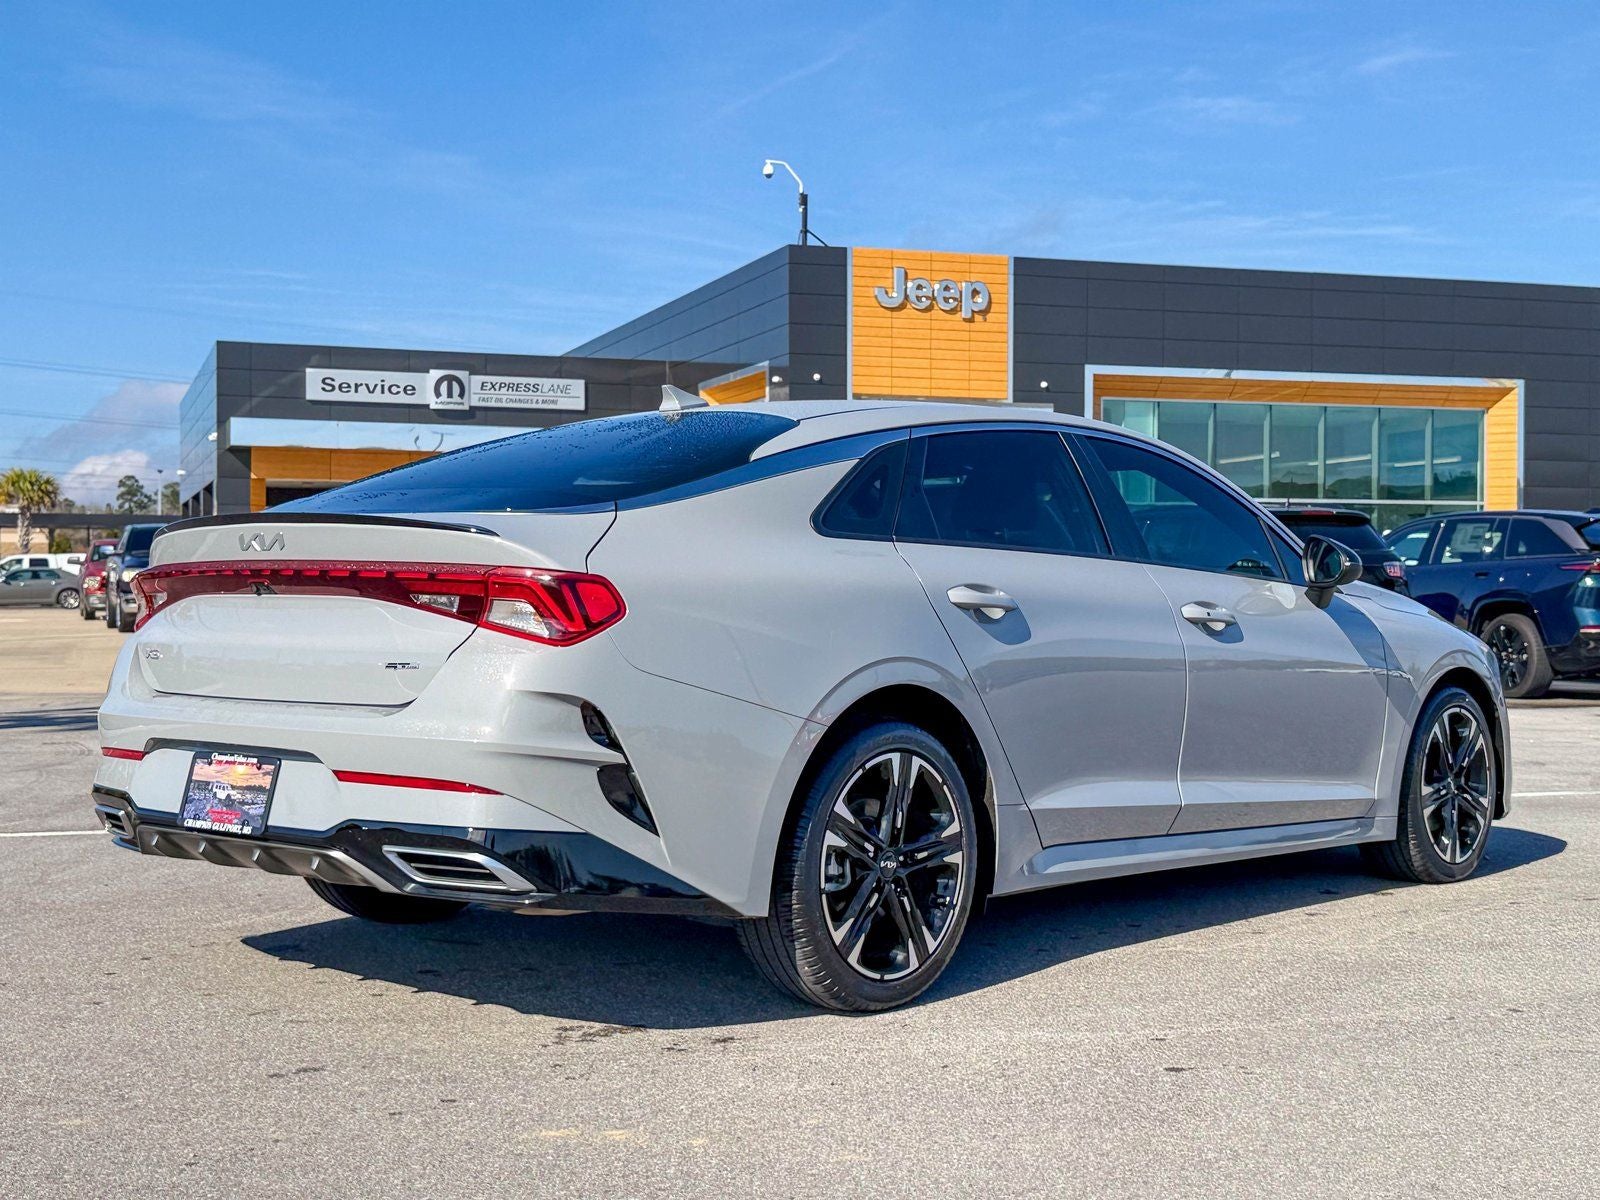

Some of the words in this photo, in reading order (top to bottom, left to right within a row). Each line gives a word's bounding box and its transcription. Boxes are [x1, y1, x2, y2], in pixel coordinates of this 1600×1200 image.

[873, 266, 990, 319] Jeep
[320, 376, 417, 396] Service
[505, 397, 534, 405] CHANGES
